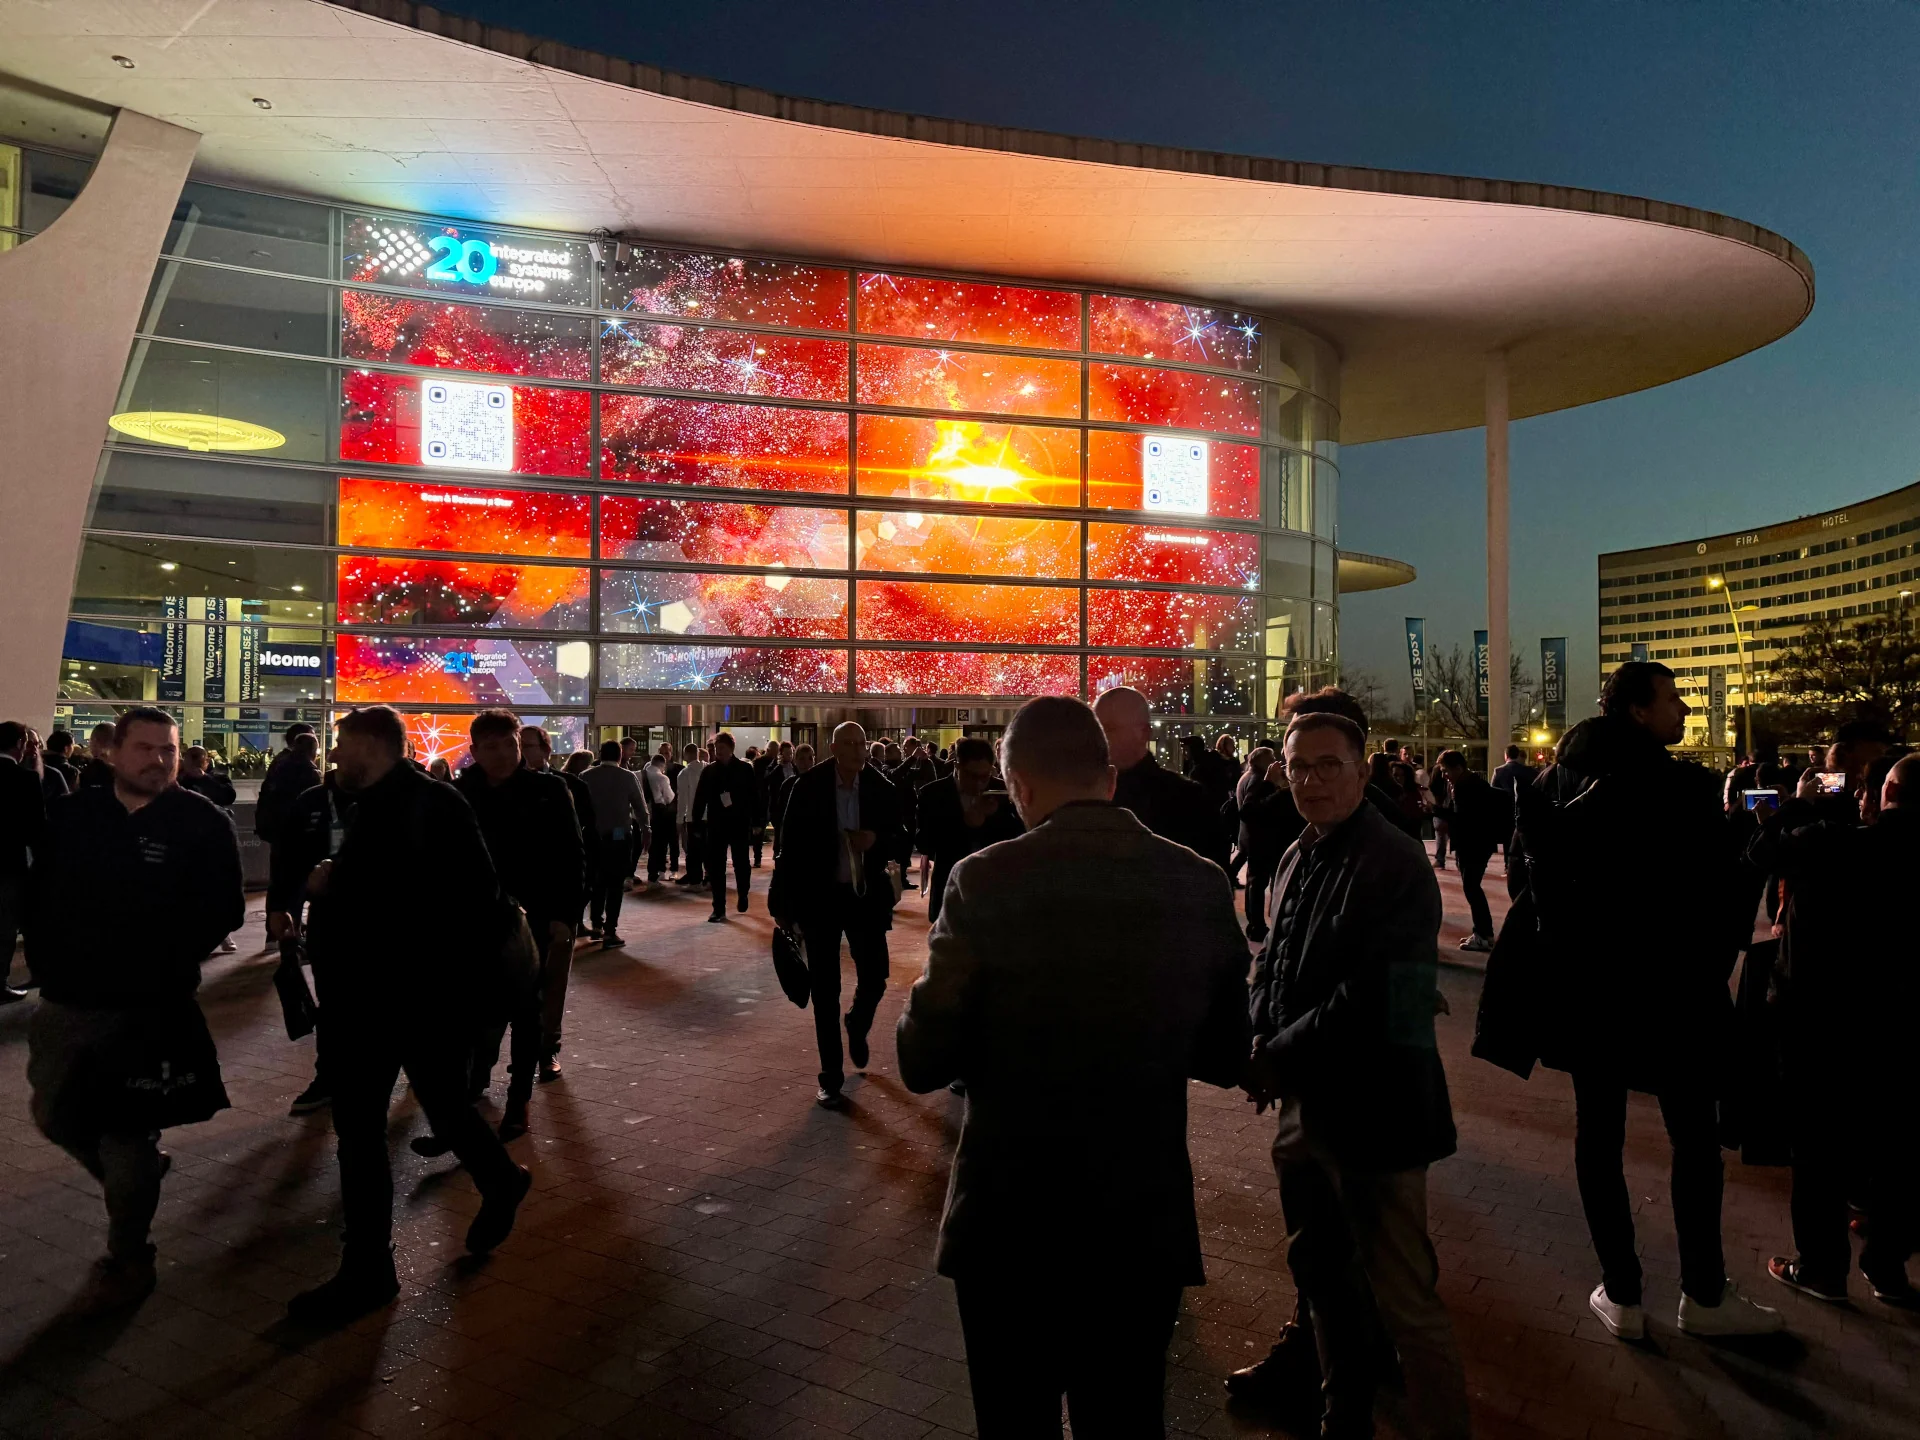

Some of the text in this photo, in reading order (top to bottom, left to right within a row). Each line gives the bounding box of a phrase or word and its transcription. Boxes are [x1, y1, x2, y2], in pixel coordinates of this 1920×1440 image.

[427, 236, 497, 283] 20
[489, 242, 570, 266] integrated
[509, 261, 572, 281] systems
[488, 274, 545, 292] europe
[1736, 513, 1849, 546] FIRA HOTEL
[207, 598, 216, 610] IS
[163, 623, 174, 676] Welcome
[243, 636, 251, 650] ISE
[176, 645, 184, 662] hope
[205, 627, 215, 679] Welcome
[244, 652, 251, 660] to
[260, 651, 320, 667] elcome
[471, 652, 506, 660] integrated
[657, 651, 673, 663] The
[176, 664, 183, 675] We
[444, 652, 474, 673] 20
[471, 667, 495, 675] europe
[242, 662, 251, 700] Welcome
[1715, 690, 1723, 712] SUD
